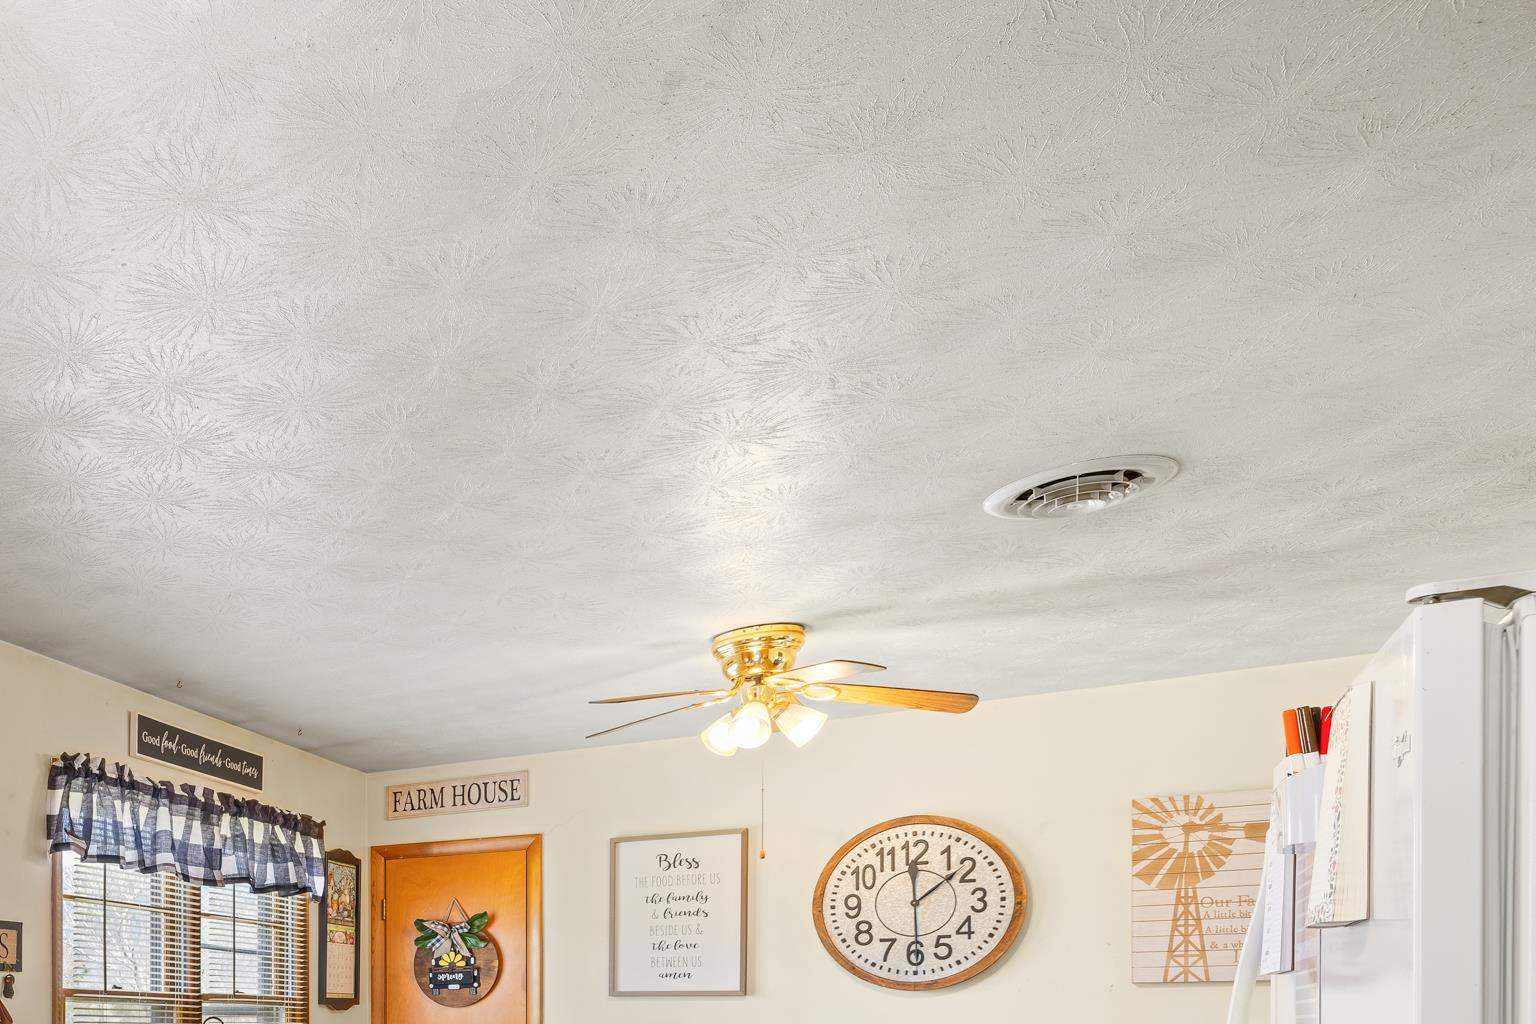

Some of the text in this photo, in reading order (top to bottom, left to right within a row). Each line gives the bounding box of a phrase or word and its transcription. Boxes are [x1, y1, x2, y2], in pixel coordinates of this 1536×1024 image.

[142, 730, 259, 778] Good food Good friends Good times
[392, 778, 521, 813] FARM HOUSE
[655, 852, 700, 871] Bless
[875, 846, 896, 873] 11
[901, 839, 929, 866] 12
[940, 845, 951, 871] 1
[651, 875, 673, 888] FOOD
[676, 873, 706, 887] BEFORE
[709, 872, 721, 885] US
[850, 864, 876, 892] 10
[959, 857, 977, 884] 2
[645, 890, 711, 904] the family
[843, 894, 862, 919] 9
[970, 887, 988, 913] 3
[1200, 894, 1256, 908] Our Fa
[663, 907, 709, 920] friends
[1203, 911, 1210, 919] A
[1214, 910, 1235, 919] little
[681, 923, 692, 935] US
[854, 920, 874, 946] 8
[955, 915, 975, 940] 4
[1205, 925, 1212, 933] A
[1215, 925, 1237, 933] little
[652, 939, 699, 951] the love
[879, 938, 897, 963] 7
[906, 940, 925, 967] 6
[933, 935, 953, 960] 5
[650, 955, 702, 968] BETWEEN US
[658, 971, 694, 980] amen
